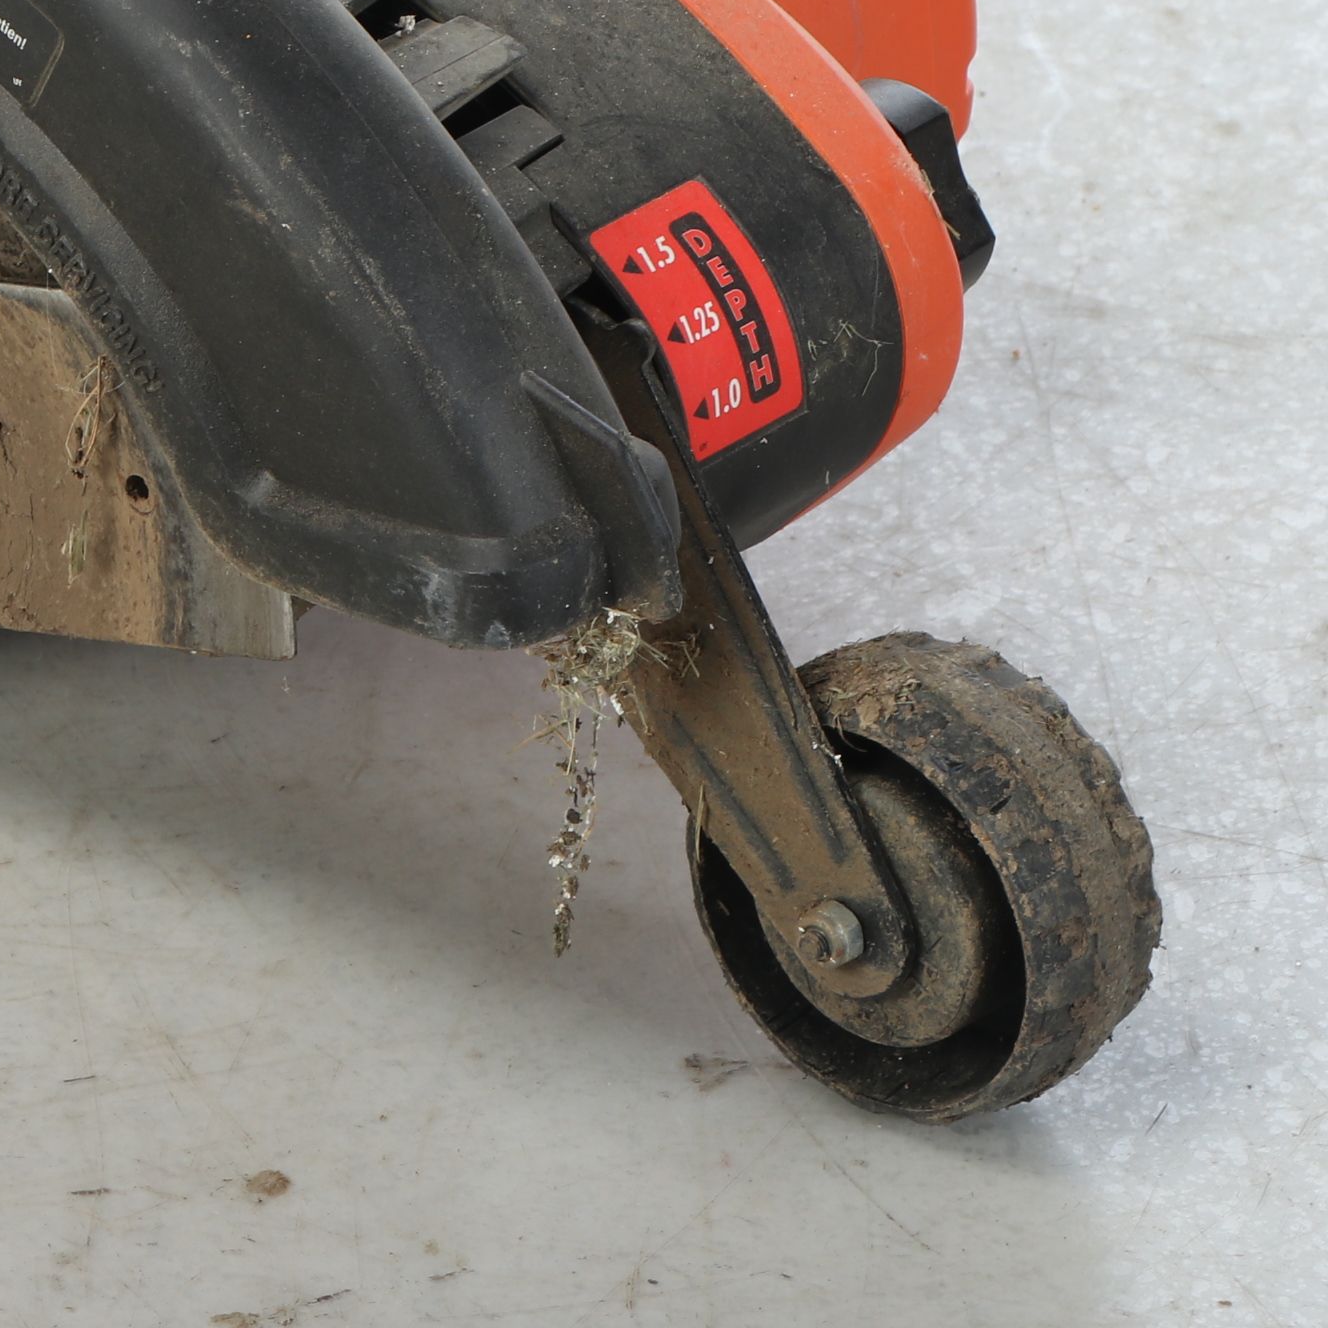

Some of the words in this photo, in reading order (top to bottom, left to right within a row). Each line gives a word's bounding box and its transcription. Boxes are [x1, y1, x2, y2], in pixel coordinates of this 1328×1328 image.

[637, 236, 676, 273] 1.5
[679, 301, 720, 344] 1.25
[681, 228, 774, 391] DEPTH
[712, 378, 741, 418] 1.0
